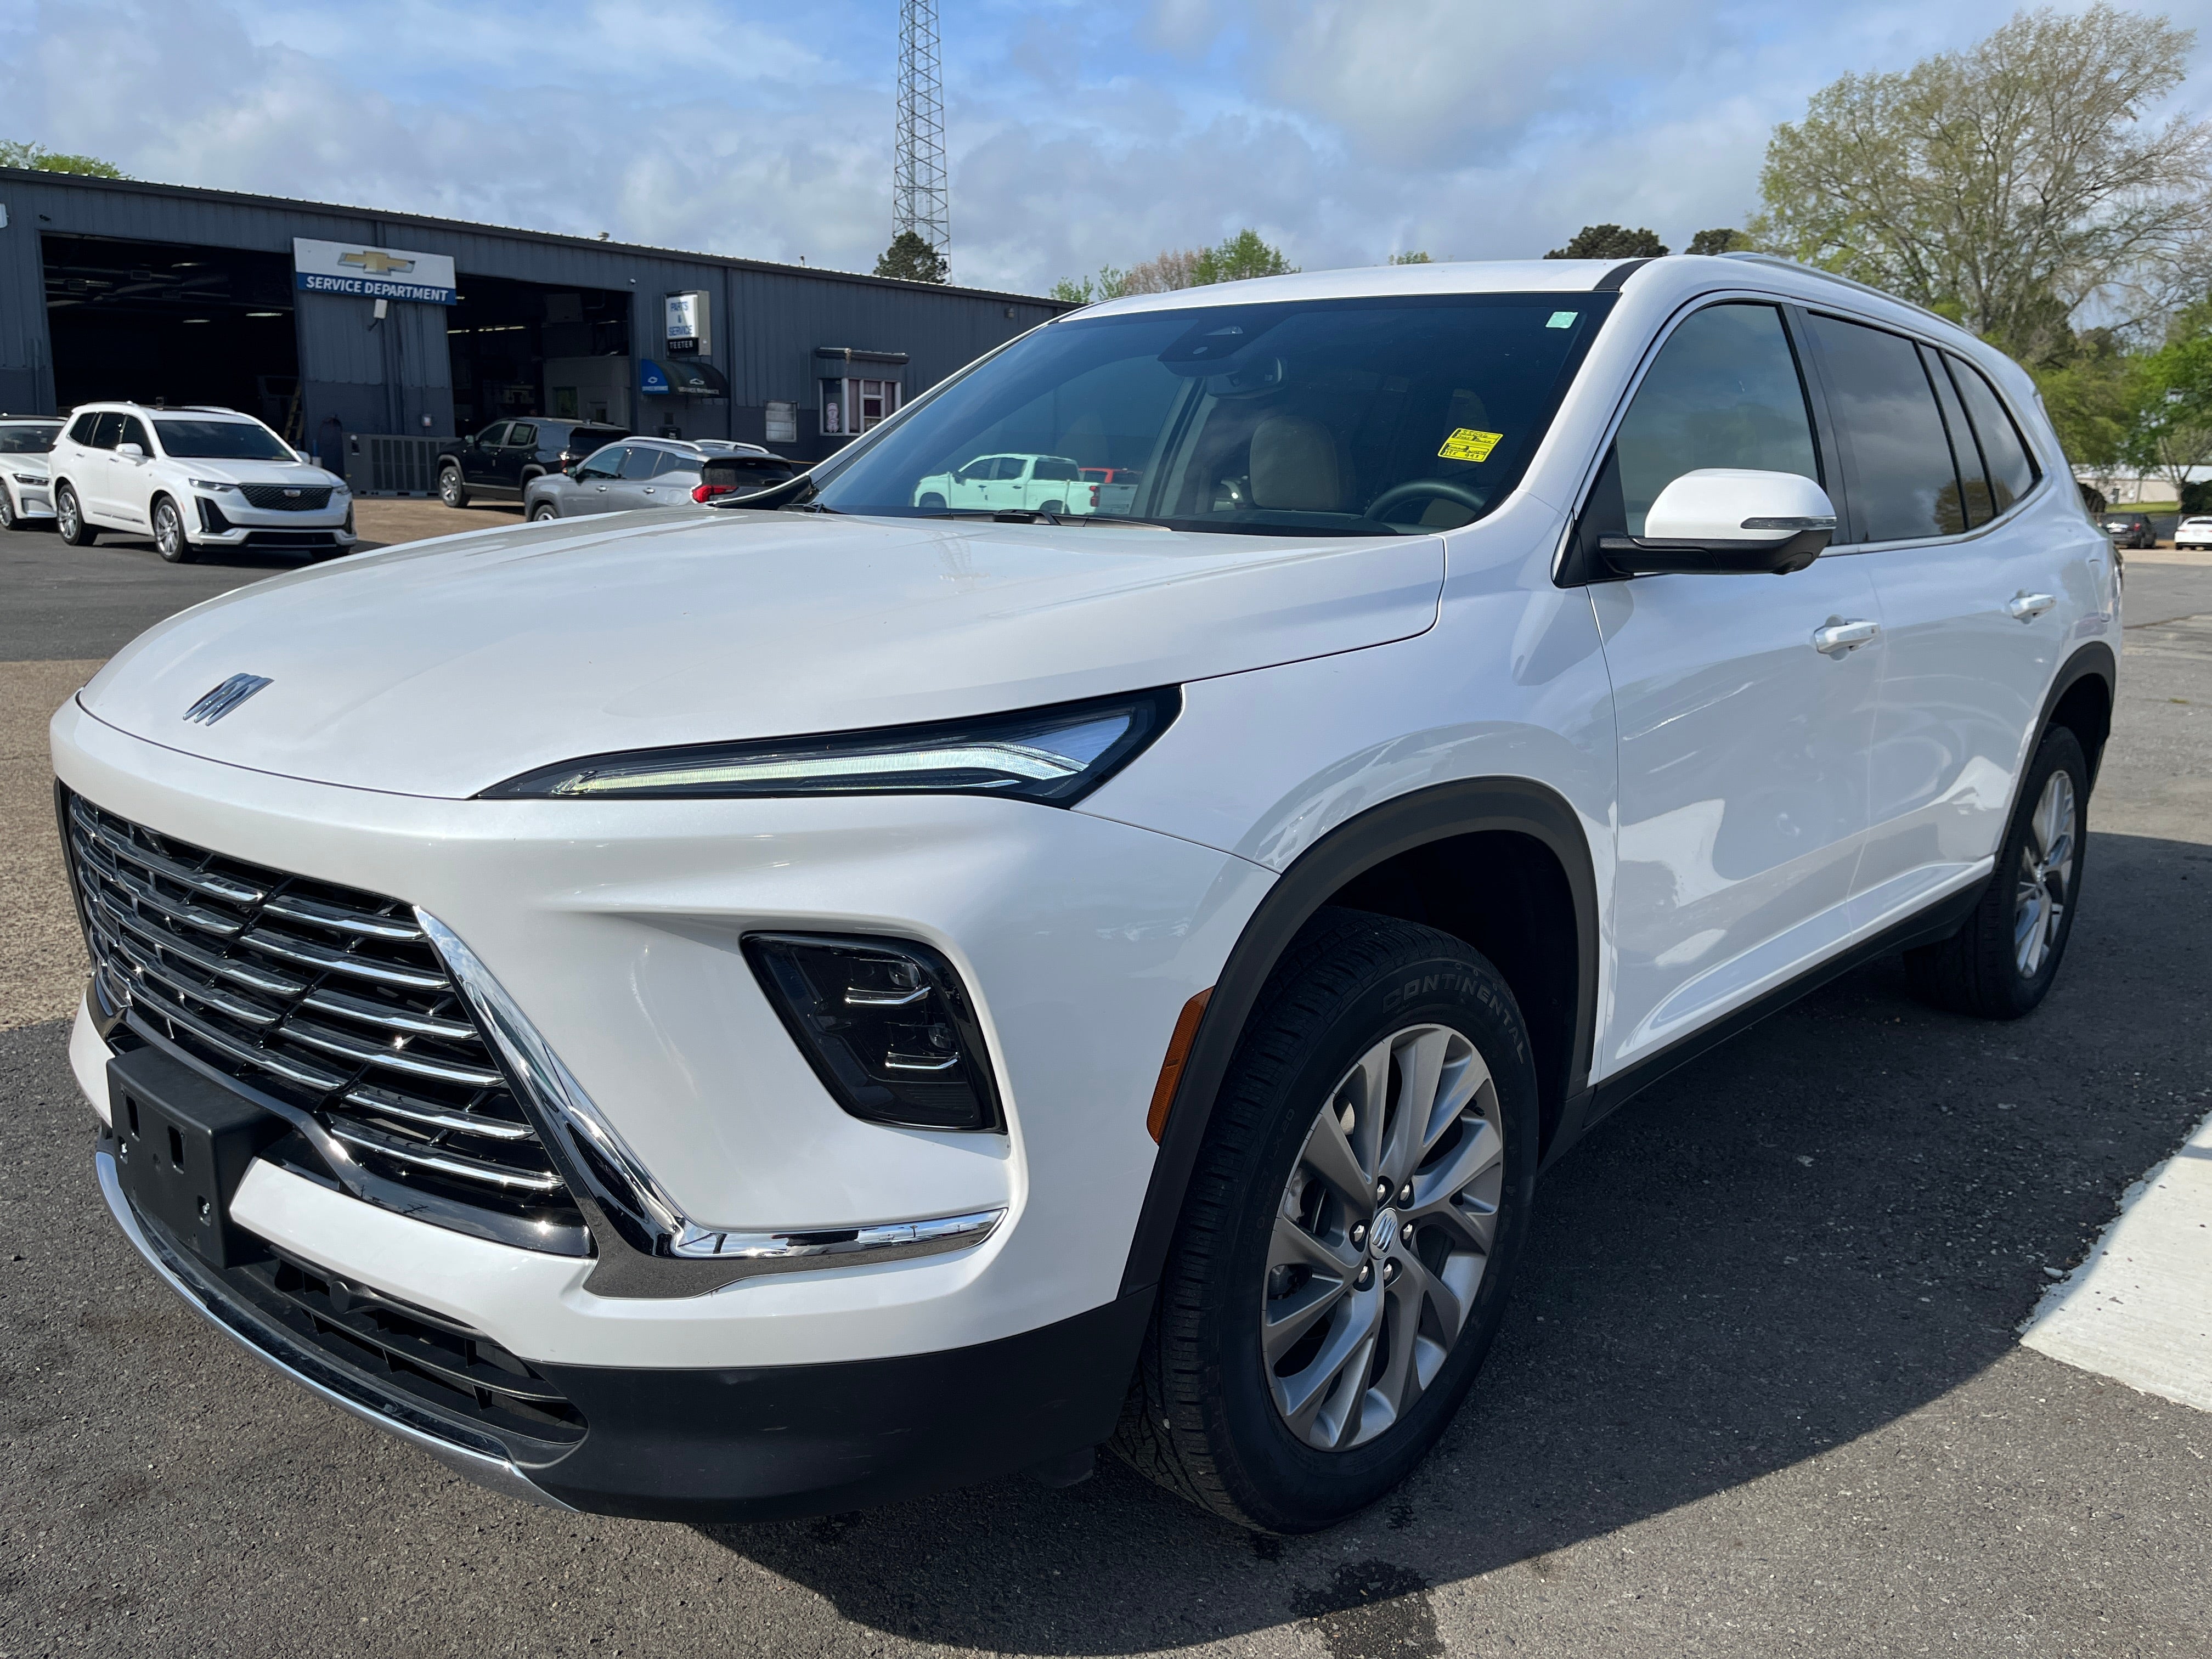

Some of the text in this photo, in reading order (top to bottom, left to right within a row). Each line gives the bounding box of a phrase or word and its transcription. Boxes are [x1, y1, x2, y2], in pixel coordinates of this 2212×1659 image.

[306, 276, 448, 302] SERVICE DEPARTMENT
[669, 325, 692, 336] SERVICE
[1381, 973, 1524, 1064] CONTINENTAL
